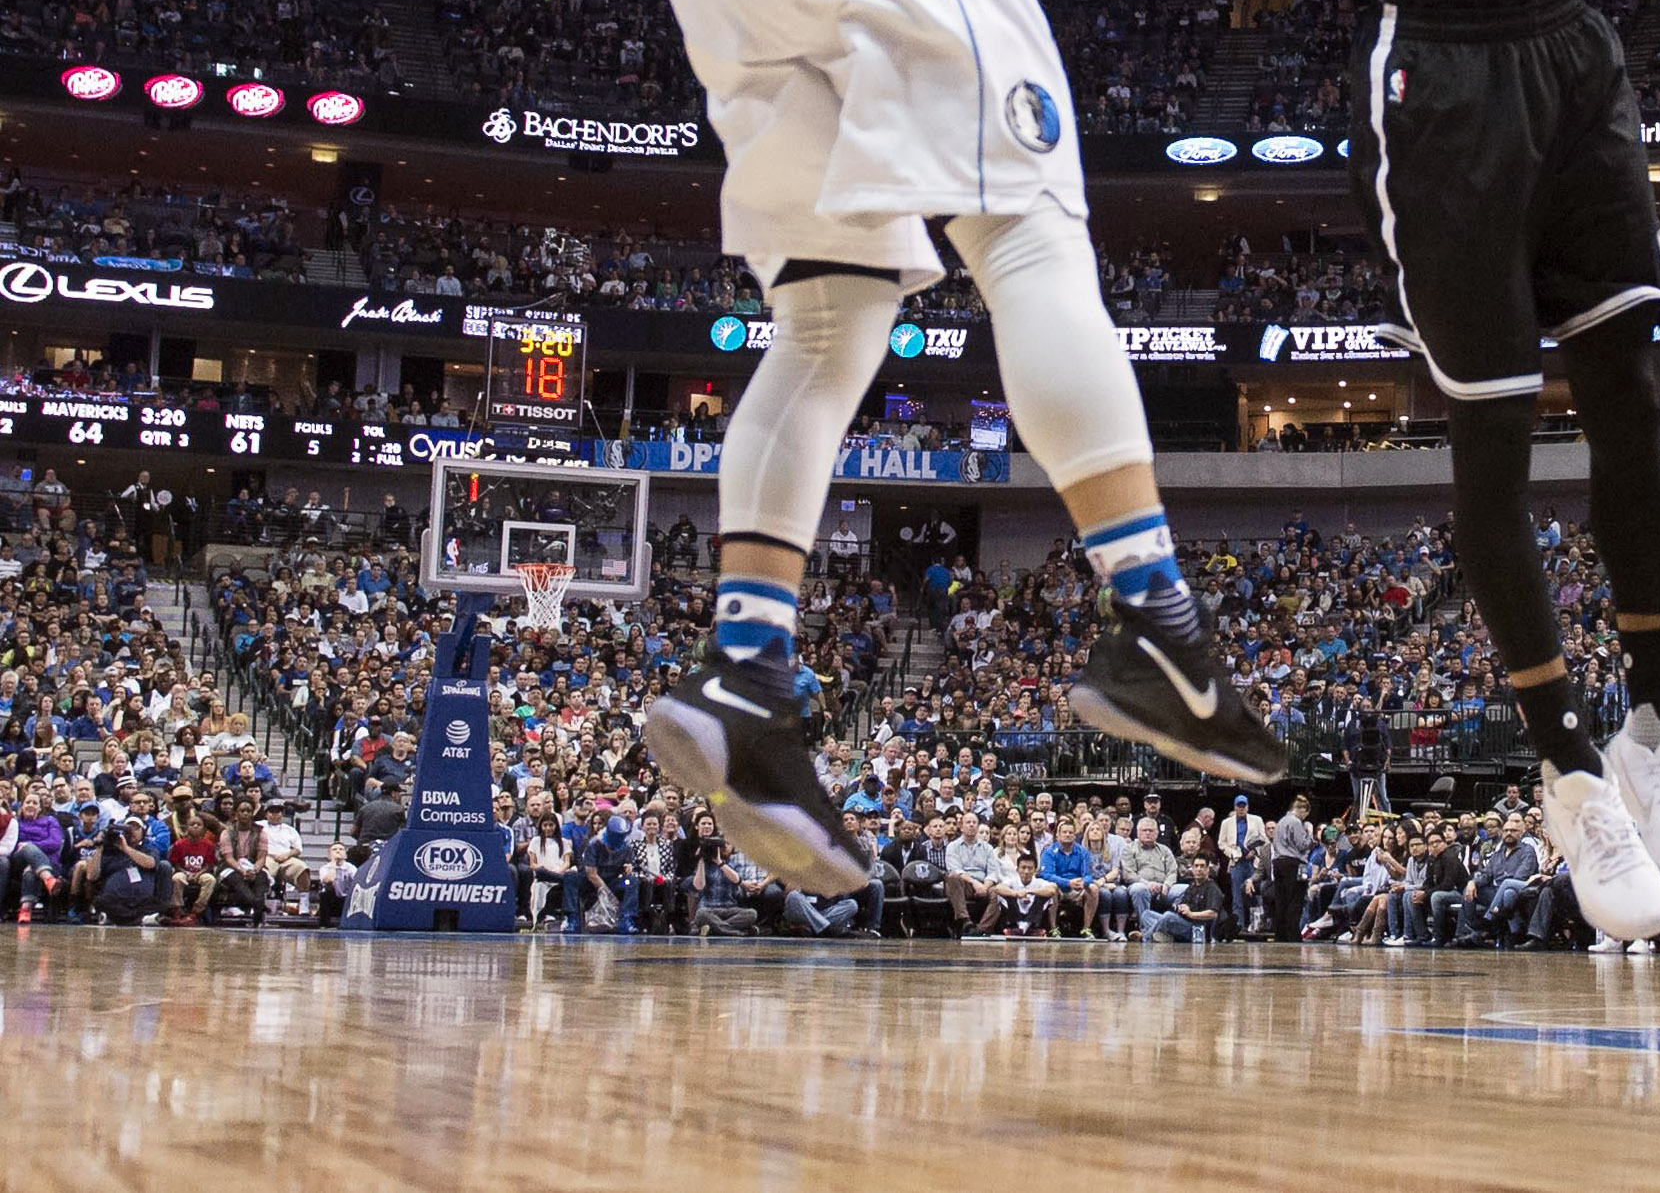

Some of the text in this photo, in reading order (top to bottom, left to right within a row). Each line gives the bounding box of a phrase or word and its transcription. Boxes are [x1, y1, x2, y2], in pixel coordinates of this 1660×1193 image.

[523, 111, 698, 146] BACHENDORF'S
[58, 276, 214, 309] LEXUS
[747, 322, 776, 339] TX
[926, 329, 968, 346] TXU
[1113, 327, 1215, 351] IP TICKET
[1290, 327, 1378, 351] VIP TIC
[520, 329, 573, 356] 3:20
[926, 347, 963, 358] energy
[525, 357, 564, 401] 18
[42, 402, 129, 421] MAVERICKS
[140, 408, 186, 427] 3:20
[516, 407, 577, 420] TISSOT
[225, 414, 264, 431] NETS
[295, 422, 332, 435] FOULS
[69, 421, 103, 445] 64
[140, 431, 189, 447] QTR 3
[230, 431, 260, 454] 61
[308, 440, 320, 455] 5
[861, 452, 936, 478] HALL
[442, 686, 481, 697] SPALDING
[442, 748, 471, 758] AT&T
[422, 791, 460, 805] BBVA
[420, 808, 486, 824] Compass
[430, 846, 468, 864] FOX
[429, 863, 468, 872] SPORTS
[389, 881, 506, 903] SOUTHWEST
